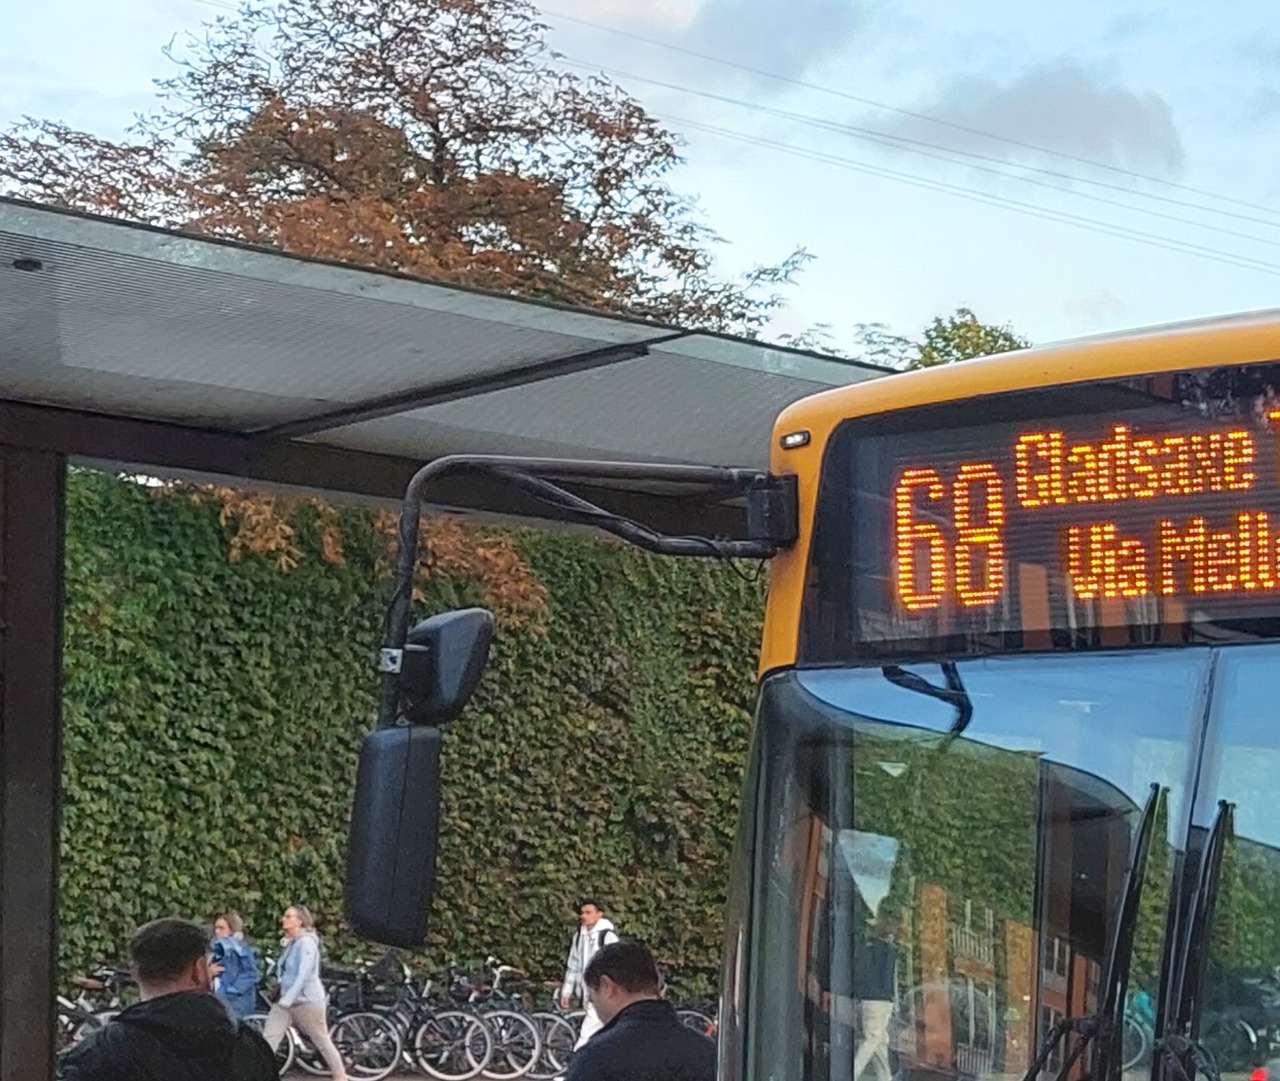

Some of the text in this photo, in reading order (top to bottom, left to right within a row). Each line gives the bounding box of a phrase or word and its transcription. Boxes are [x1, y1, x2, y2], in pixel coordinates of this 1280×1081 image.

[1014, 423, 1254, 508] Gladsaxe
[892, 462, 1005, 611] 68
[1066, 521, 1149, 600] Via
